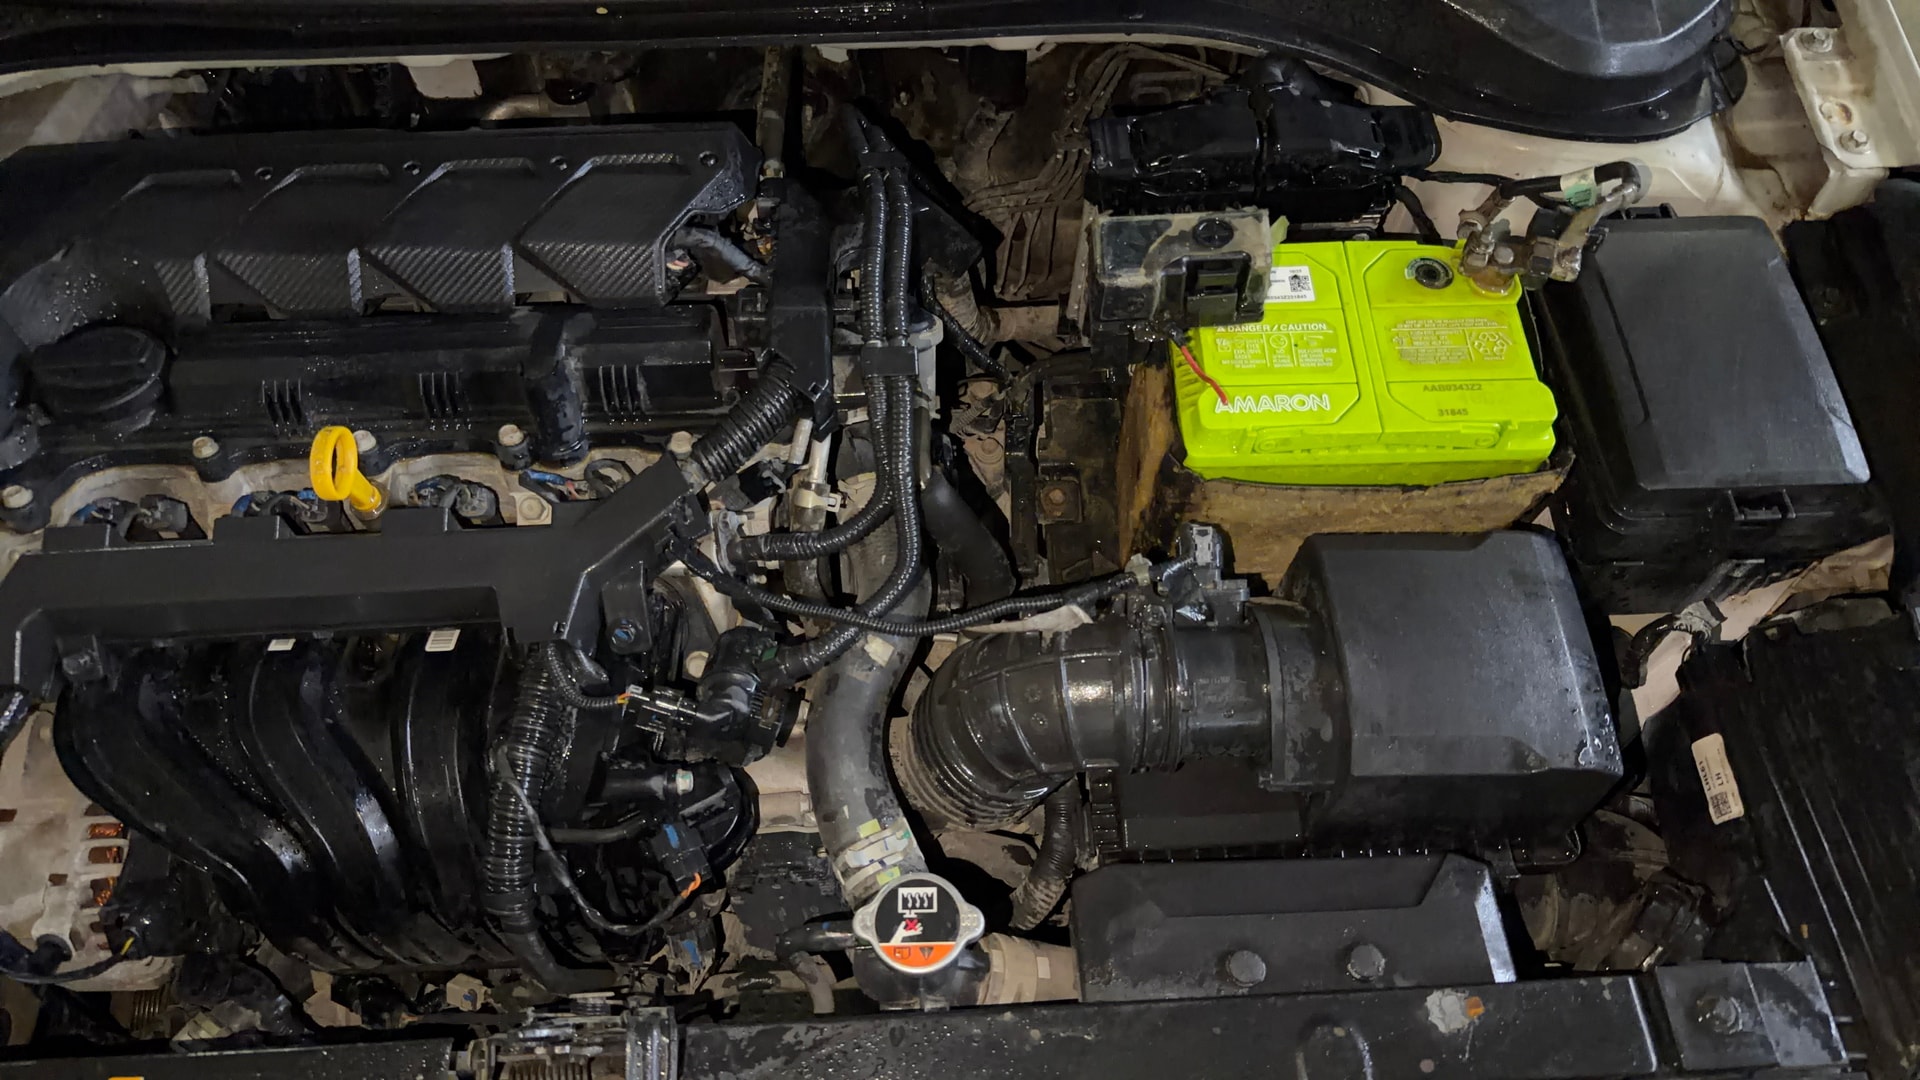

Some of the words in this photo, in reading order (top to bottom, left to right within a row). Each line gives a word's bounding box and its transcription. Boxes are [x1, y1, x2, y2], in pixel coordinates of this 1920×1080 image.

[1228, 324, 1270, 332] DANGER
[1280, 323, 1327, 331] CAUTION
[1215, 394, 1331, 414] AMARON
[1438, 408, 1469, 417] 31845
[1715, 772, 1724, 786] LH
